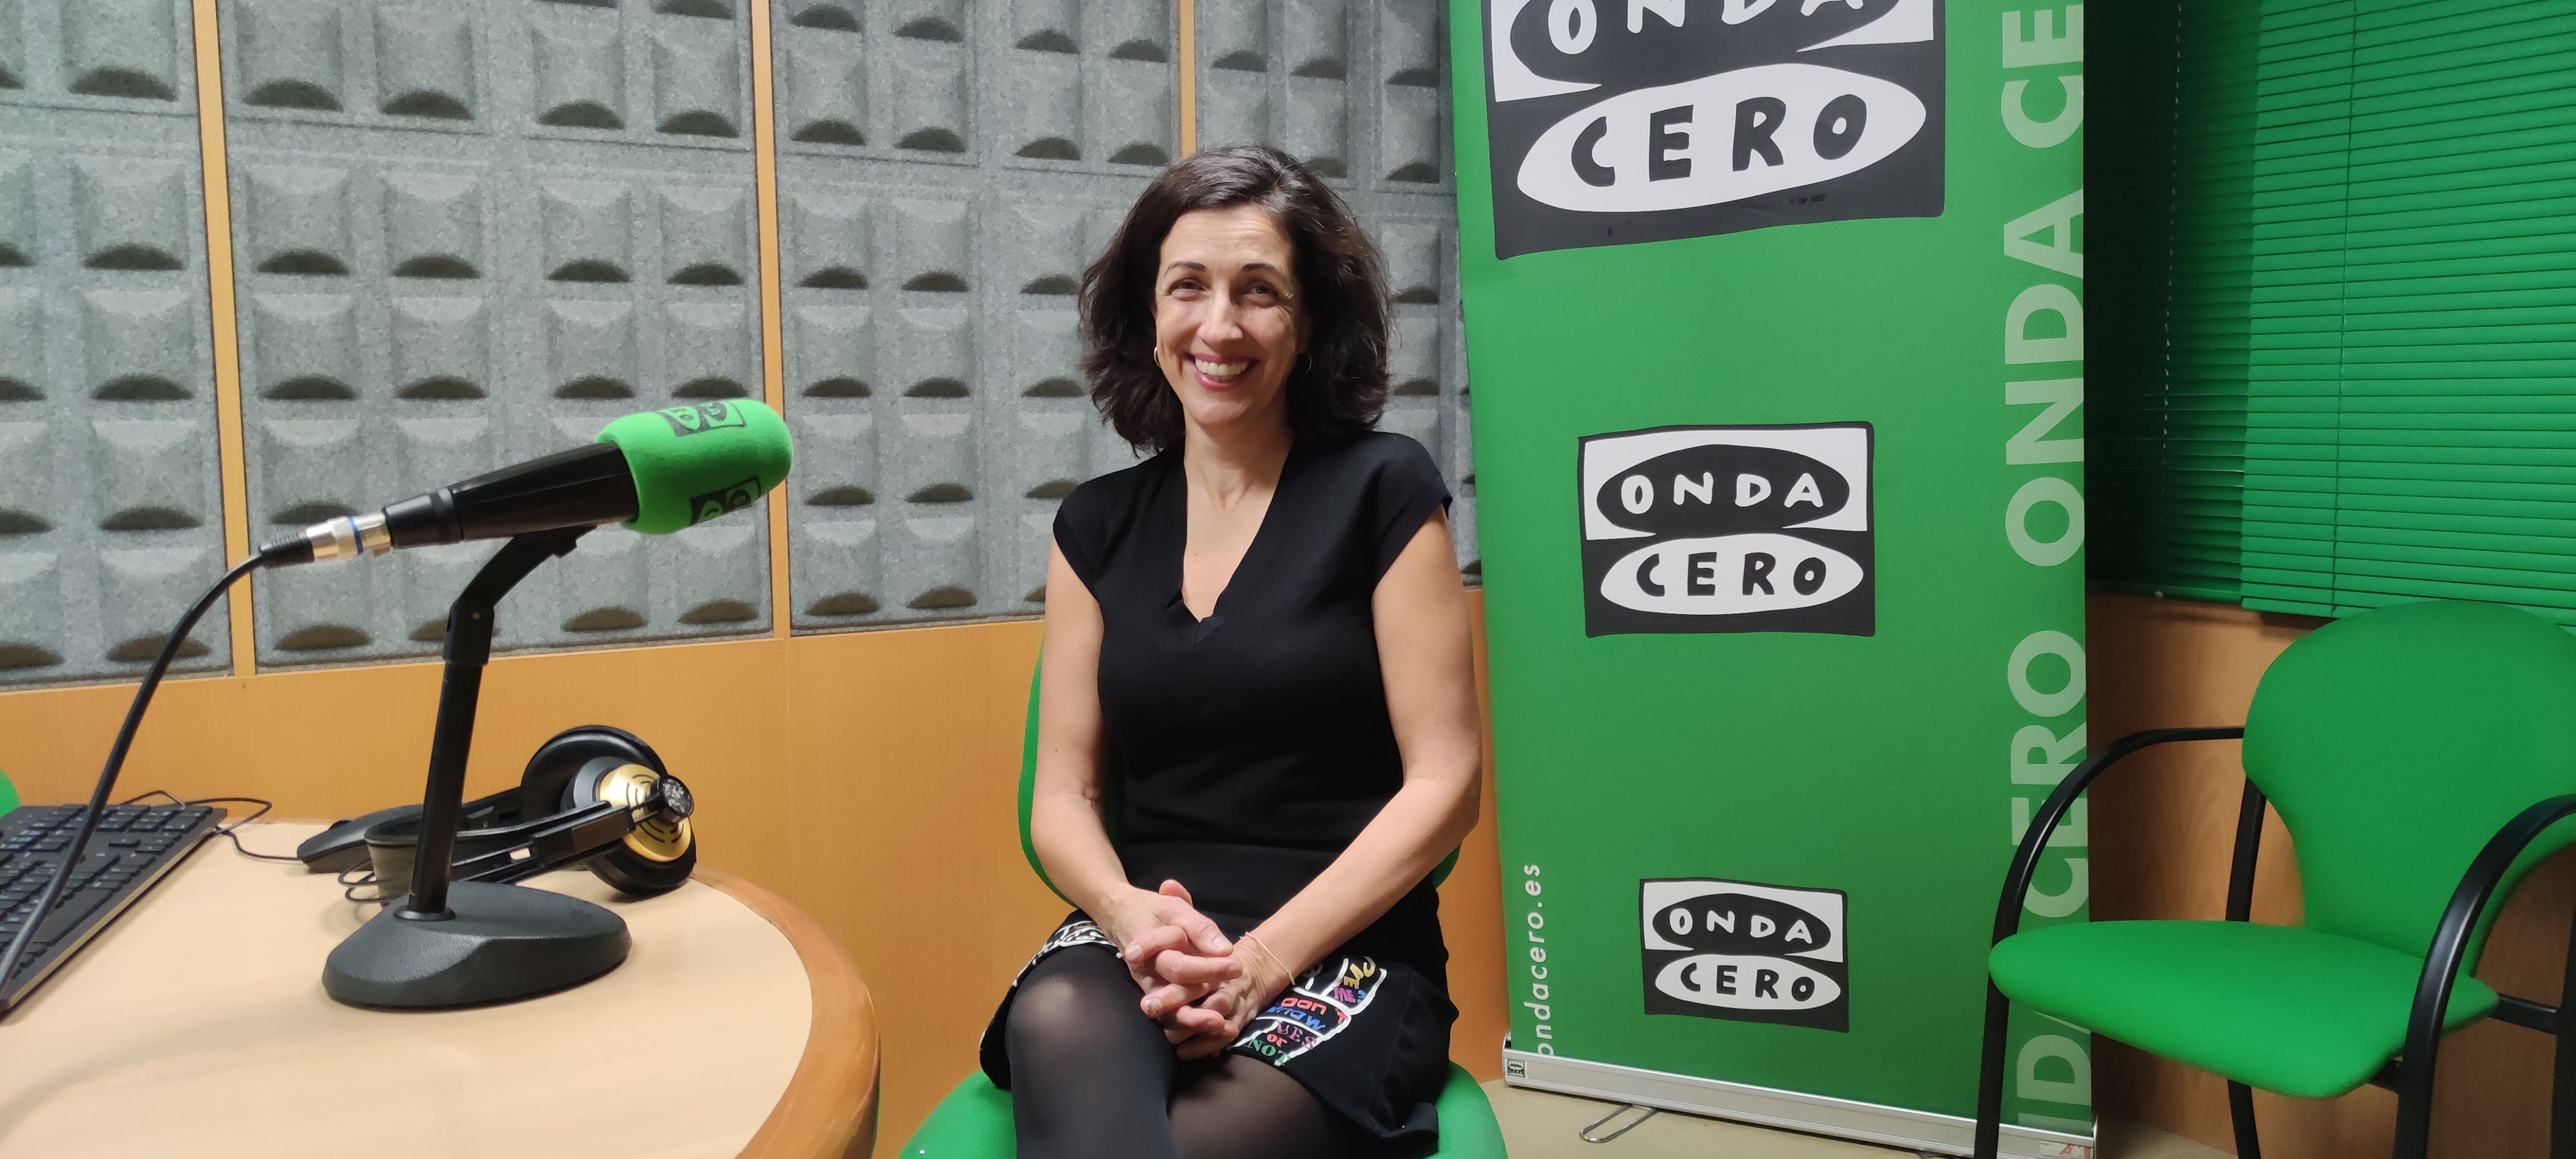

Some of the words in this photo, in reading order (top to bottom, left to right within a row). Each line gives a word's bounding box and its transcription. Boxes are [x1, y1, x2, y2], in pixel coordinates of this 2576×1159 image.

[1571, 94, 1867, 187] CERO
[2004, 188, 2084, 566] ONDA
[1621, 472, 1823, 514] ONDA
[1636, 551, 1826, 597] CERO
[2007, 630, 2088, 918] CERO
[1670, 908, 1812, 943] ONDA
[1524, 864, 1554, 1057] ondacero.es
[1680, 962, 1815, 1001] CERO
[1276, 1021, 1318, 1050] YES
